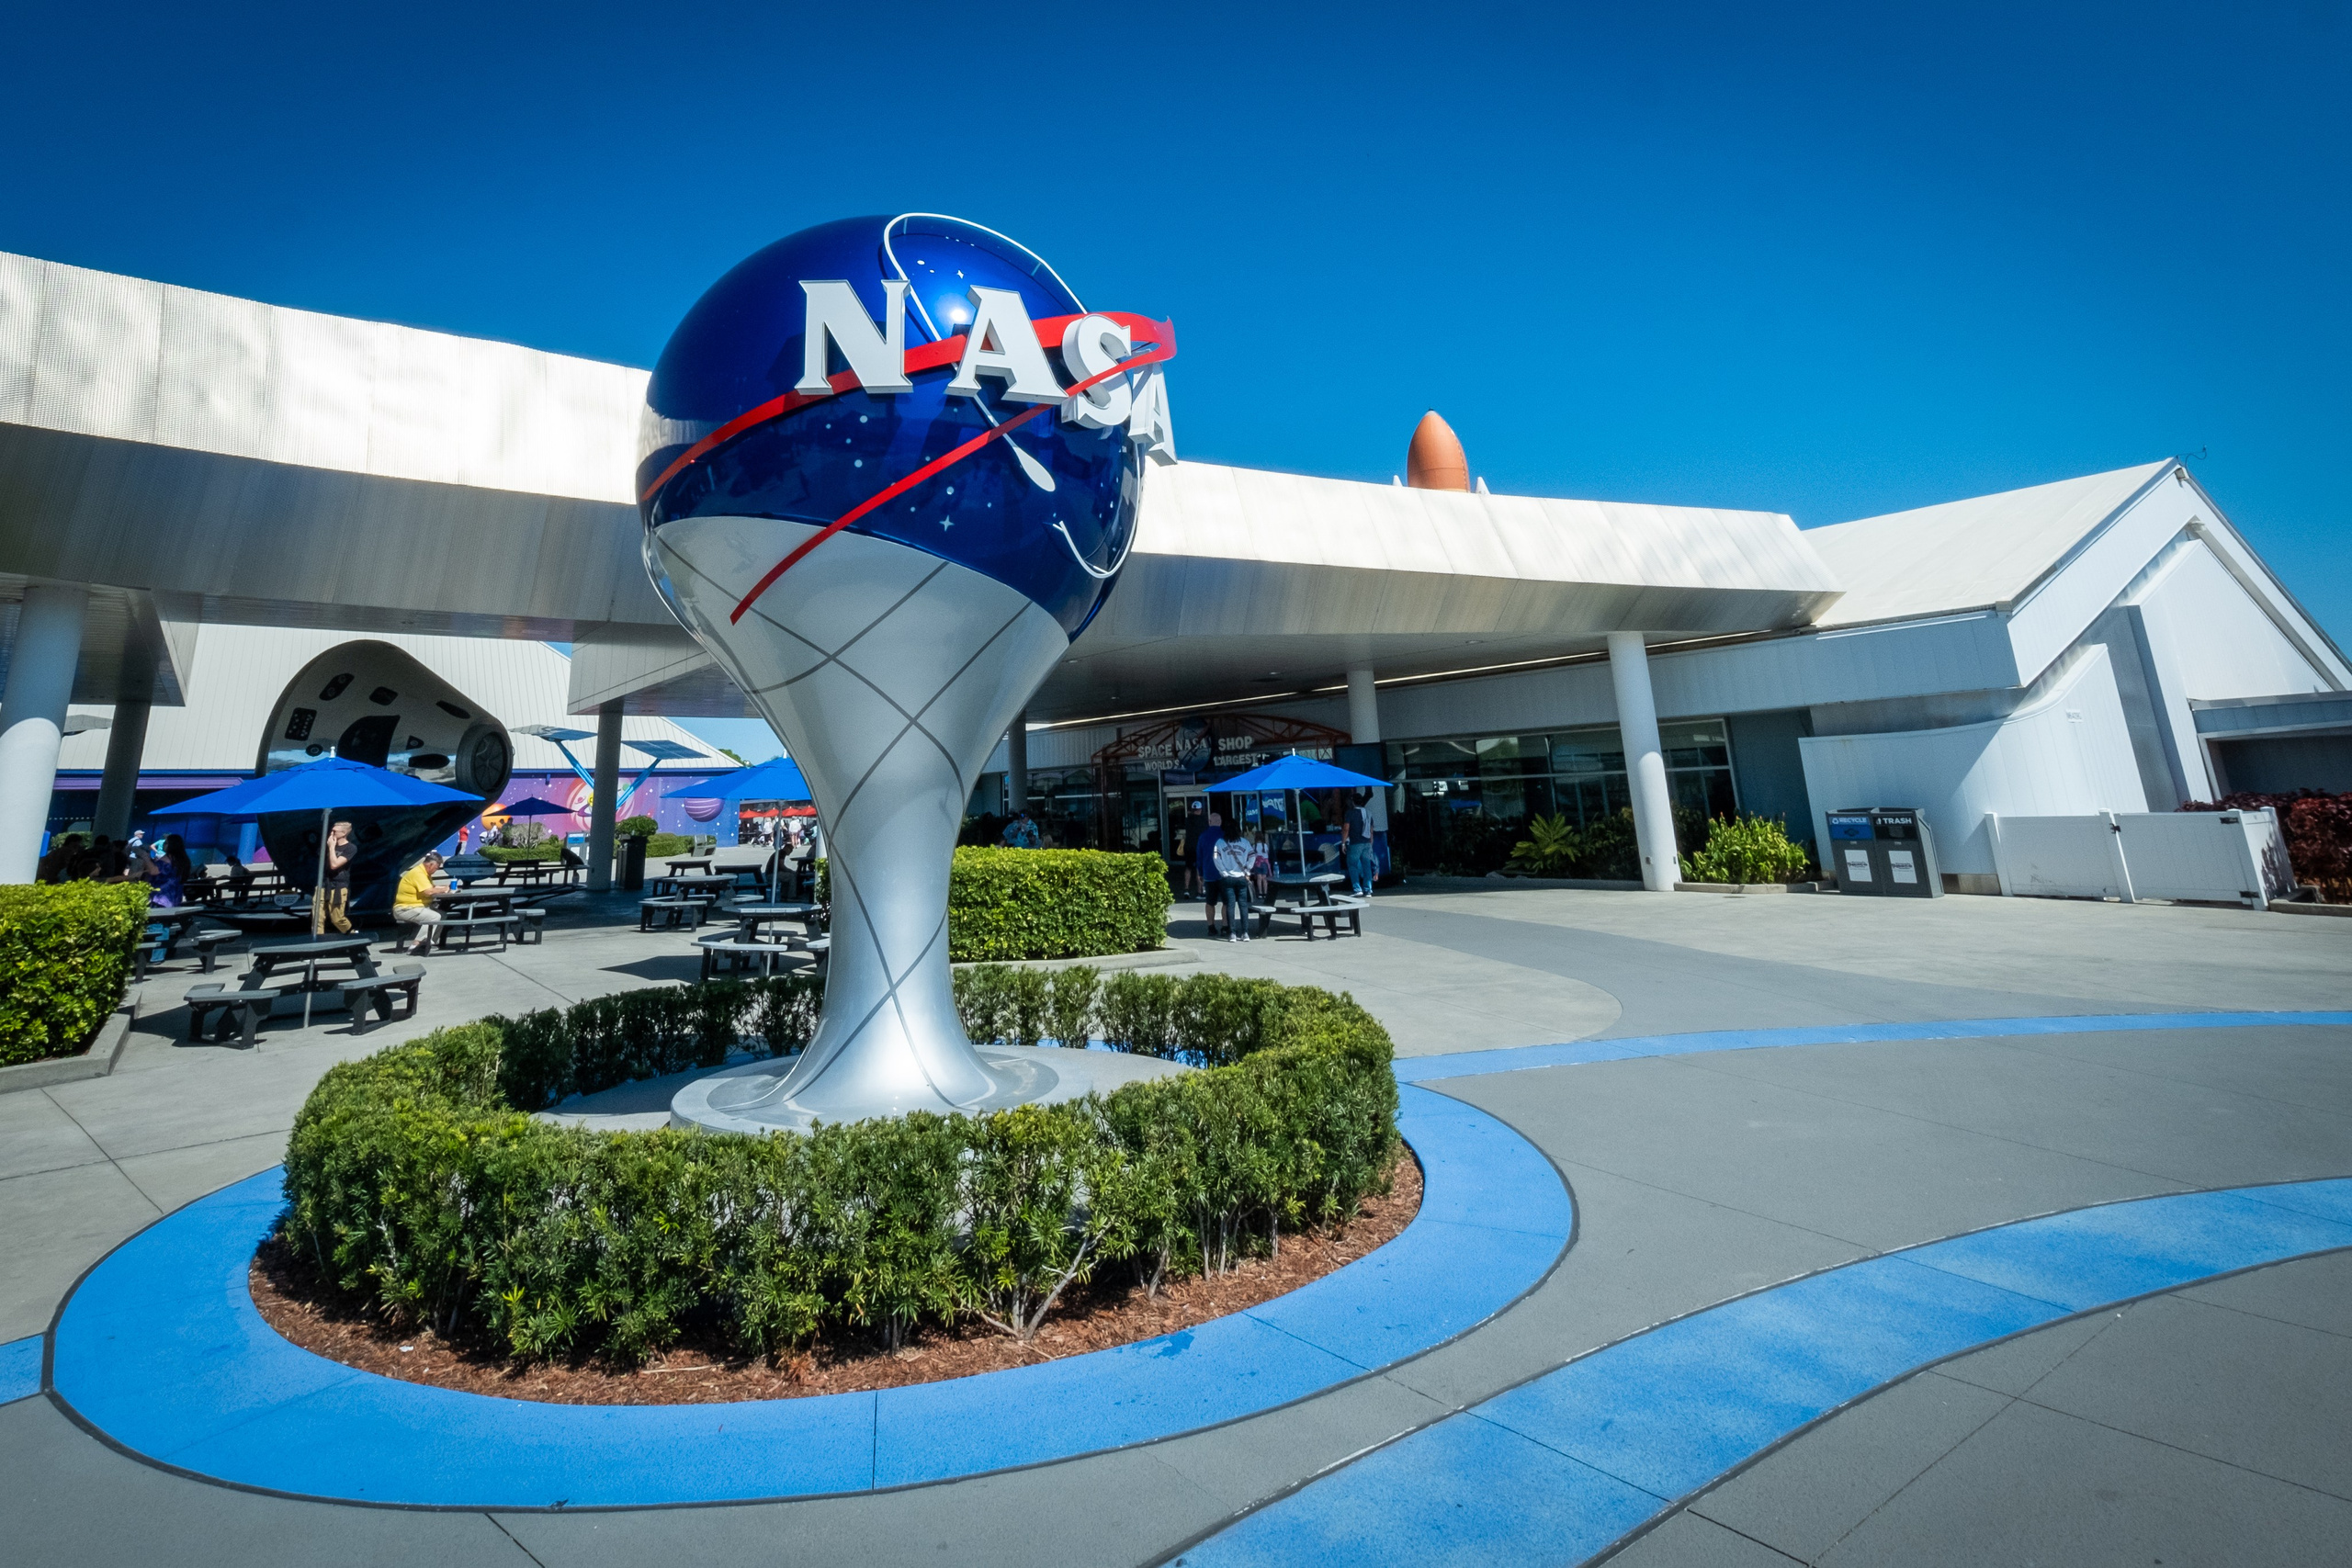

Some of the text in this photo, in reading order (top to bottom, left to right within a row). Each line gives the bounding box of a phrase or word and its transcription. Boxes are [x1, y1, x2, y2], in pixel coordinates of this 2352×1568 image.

[794, 279, 1178, 466] NASA
[1137, 736, 1252, 758] SPACE NASA SHOP
[1213, 753, 1257, 766] LARGEST
